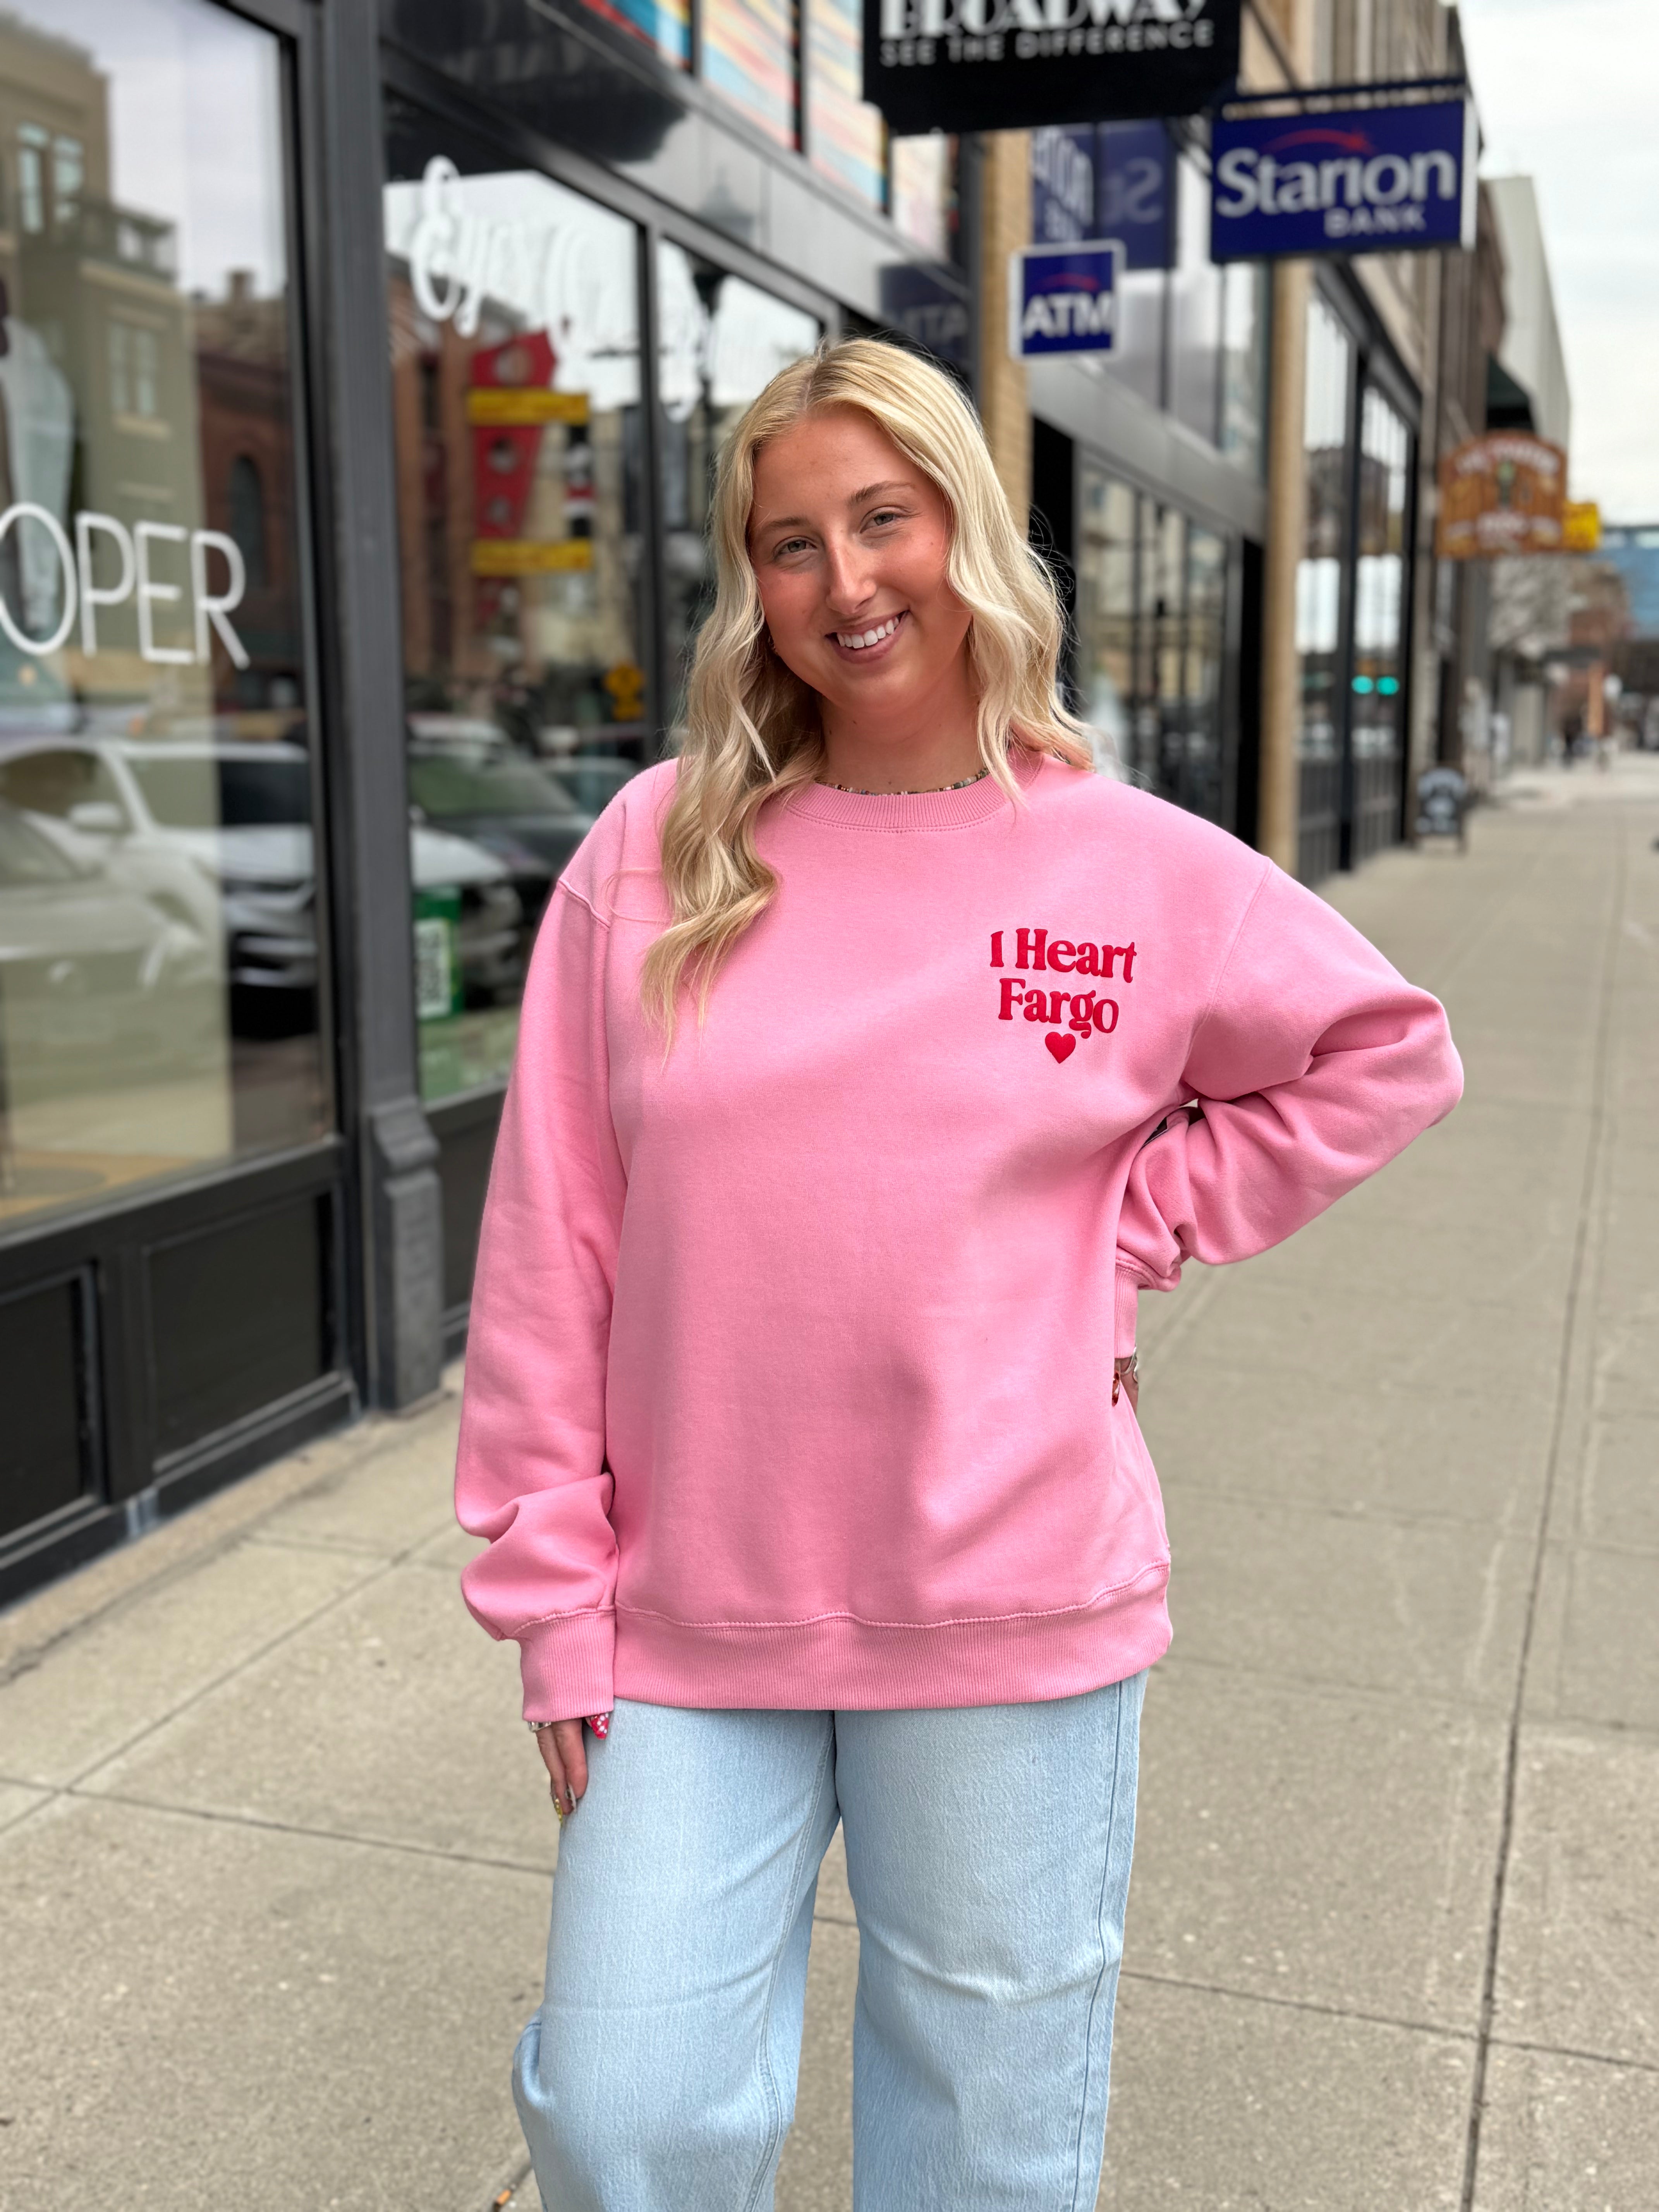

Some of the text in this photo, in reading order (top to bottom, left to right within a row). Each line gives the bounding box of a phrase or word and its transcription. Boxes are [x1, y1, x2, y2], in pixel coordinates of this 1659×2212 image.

[880, 18, 1214, 67] SEE THE DIFFERENCE
[1215, 146, 1458, 218] Starion
[1323, 204, 1427, 238] BANK
[1022, 290, 1113, 339] ATM
[990, 928, 1137, 983] I Heart
[998, 978, 1119, 1039] Fargo
